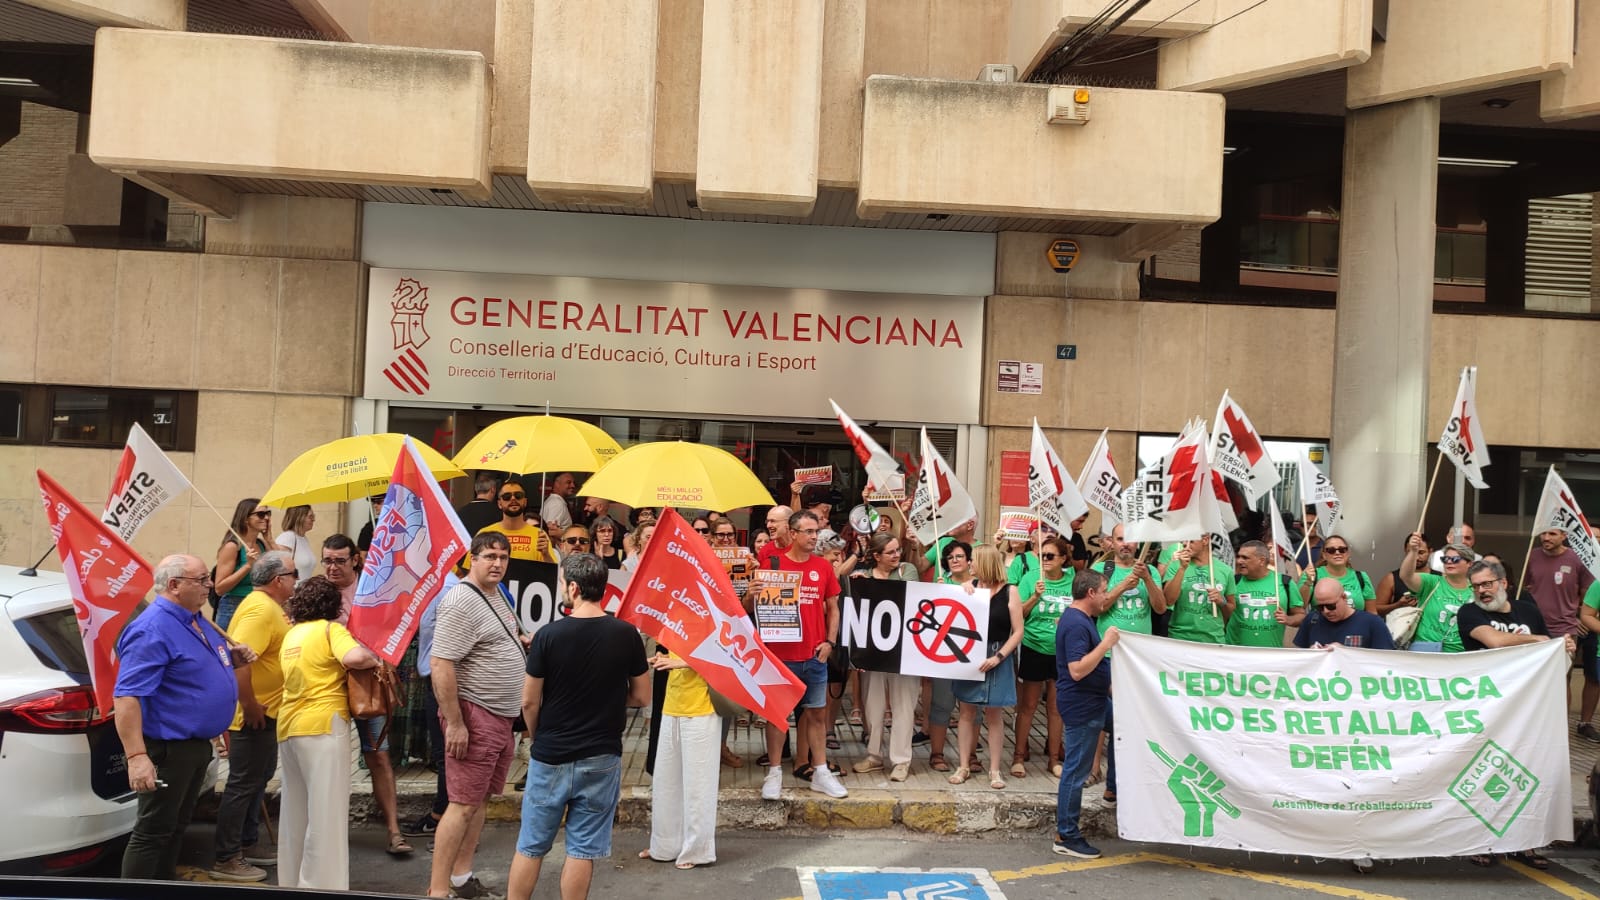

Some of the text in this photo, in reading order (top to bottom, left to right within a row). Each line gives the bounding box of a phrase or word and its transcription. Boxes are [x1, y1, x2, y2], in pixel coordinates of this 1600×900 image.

[450, 296, 963, 348] GENERALITAT VALENCIANA
[449, 338, 816, 373] Conselleria d'Educació, Cultura i Esport
[1060, 347, 1073, 357] 47
[448, 366, 556, 381] Direcció Territorial
[1146, 457, 1164, 522] TEPV
[716, 549, 735, 559] AGA
[787, 573, 799, 583] FP
[647, 577, 666, 592] de
[671, 588, 710, 619] classe
[841, 597, 902, 652] NO
[1159, 670, 1502, 701] L'EDUCACIÓ PÚBLICA
[1189, 706, 1235, 731] NO
[1242, 708, 1277, 733] ES
[1445, 710, 1485, 734] ES
[1289, 738, 1392, 770] DEFÉN
[1457, 750, 1530, 798] IES LAS LOMAS
[1332, 802, 1345, 810] de
